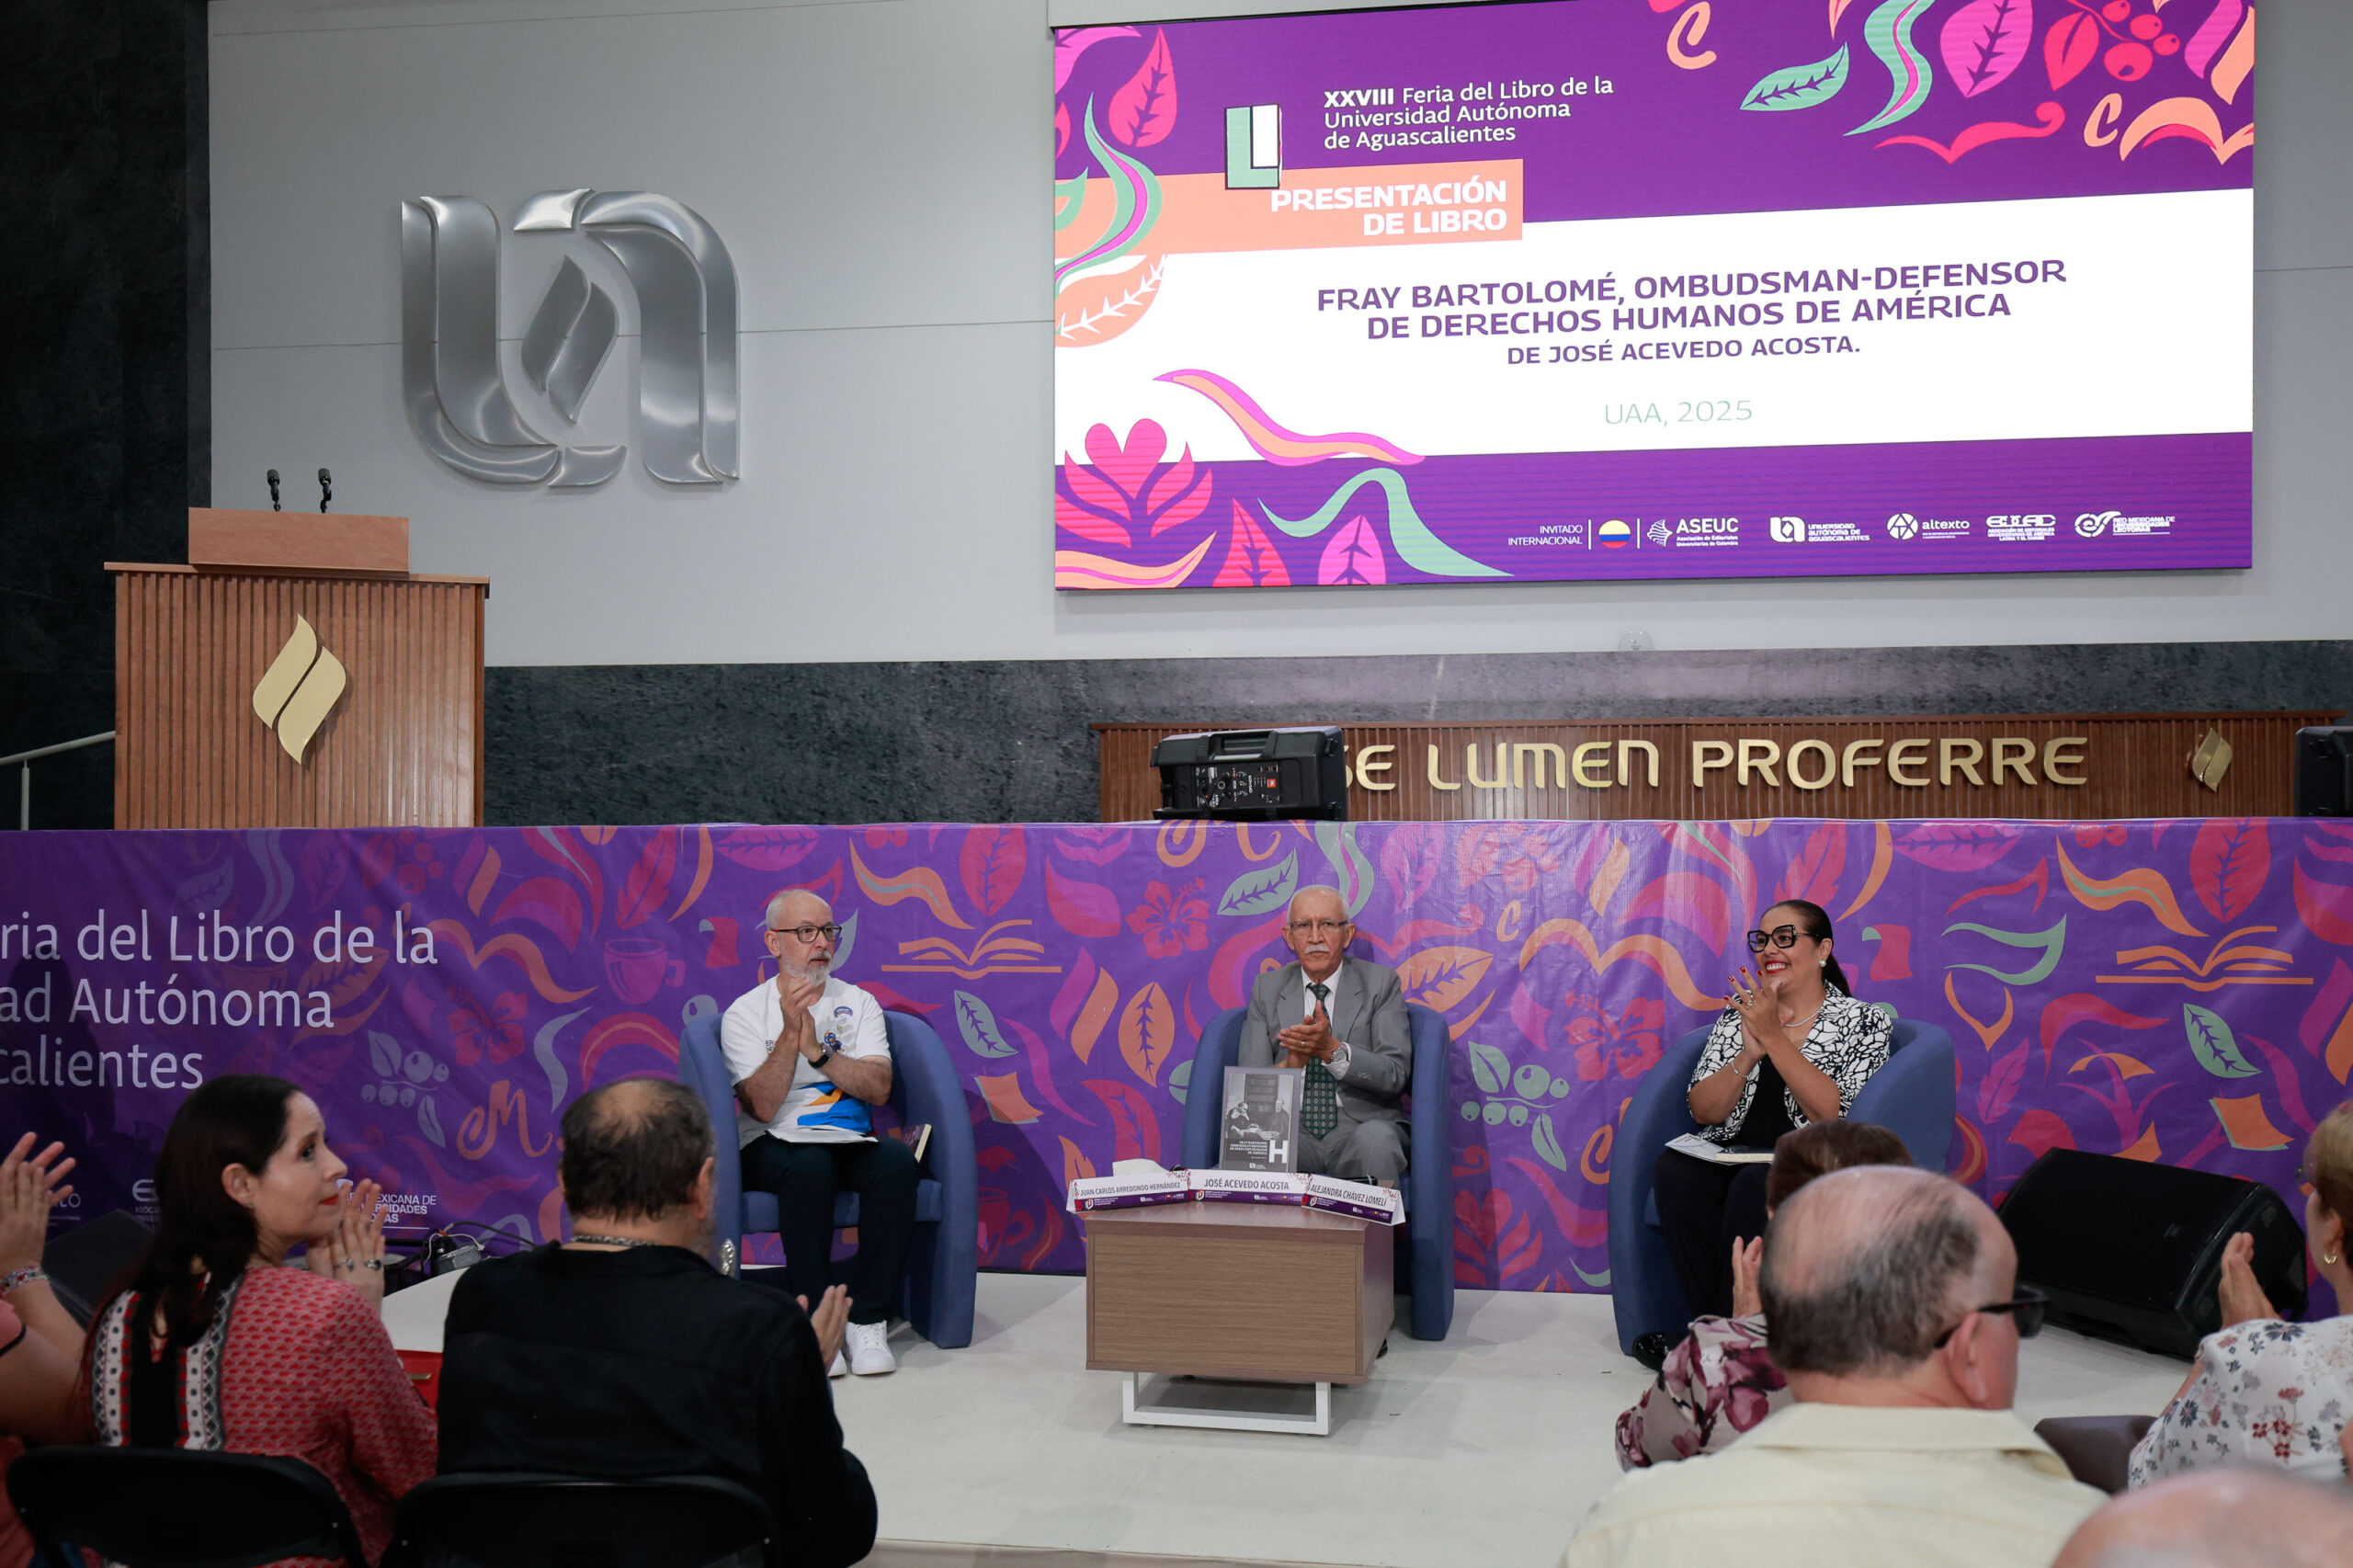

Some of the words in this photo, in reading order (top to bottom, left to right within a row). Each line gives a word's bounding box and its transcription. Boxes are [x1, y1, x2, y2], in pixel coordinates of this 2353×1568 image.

[1324, 88, 1394, 108] XXVIII
[1403, 85, 1454, 105] Feria
[1460, 81, 1493, 101] del
[1500, 79, 1554, 99] Libro
[1560, 76, 1587, 97] de
[1595, 75, 1613, 94] la
[1324, 104, 1450, 129] Universidad
[1456, 101, 1571, 122] Autónoma
[1324, 130, 1350, 150] de
[1356, 125, 1517, 152] Aguascalientes
[1270, 175, 1506, 213] PRESENTACIÓN
[1363, 212, 1405, 236] DE
[1413, 208, 1507, 234] LIBRO
[1317, 287, 1402, 311] FRAY
[1412, 271, 1625, 308] BARTOLOMÉ,
[1634, 259, 2067, 300] OMBUDSMAN-DEFENSOR
[1368, 316, 1410, 339] DE
[1421, 309, 1601, 337] DERECHOS
[1613, 301, 1784, 331] HUMANOS
[1796, 300, 1841, 324] DE
[1851, 290, 2012, 322] AMÉRICA
[1507, 347, 1541, 364] DE
[1549, 339, 1613, 363] JOSÉ
[1621, 339, 1743, 361] ACEVEDO
[1750, 335, 1861, 357] ACOSTA.
[1605, 402, 1668, 427] UAA,
[1677, 400, 1753, 424] 2025
[1540, 524, 1583, 534] INVITADO
[1676, 517, 1739, 533] ASEUC
[1922, 518, 1971, 530] altexto
[1508, 536, 1583, 546] INTERNACIONAL
[1344, 744, 1396, 790] E
[1427, 739, 1660, 790] LUMEN
[1692, 737, 2088, 790] PROFERRE
[2, 911, 60, 960] ria
[77, 909, 151, 961] del
[170, 912, 294, 963] Libro
[313, 911, 374, 963] de
[396, 911, 438, 964] la
[0, 971, 51, 1023] ad
[70, 973, 334, 1028] Autónoma
[1269, 1140, 1288, 1163] H
[1095, 1187, 1115, 1195] CARLOS
[1116, 1184, 1149, 1193] ARREDONDO
[1150, 1181, 1180, 1190] HERNÁNDEZ
[1204, 1177, 1222, 1187] JOSÉ
[1223, 1179, 1259, 1188] ACEVEDO
[1260, 1181, 1290, 1190] ACOSTA
[1311, 1184, 1342, 1198] ALEJANDRA
[1343, 1190, 1365, 1202] CHÁVEZ
[1366, 1196, 1387, 1207] LOMELÍ
[366, 1194, 420, 1205] EXICANA
[422, 1196, 437, 1205] DE
